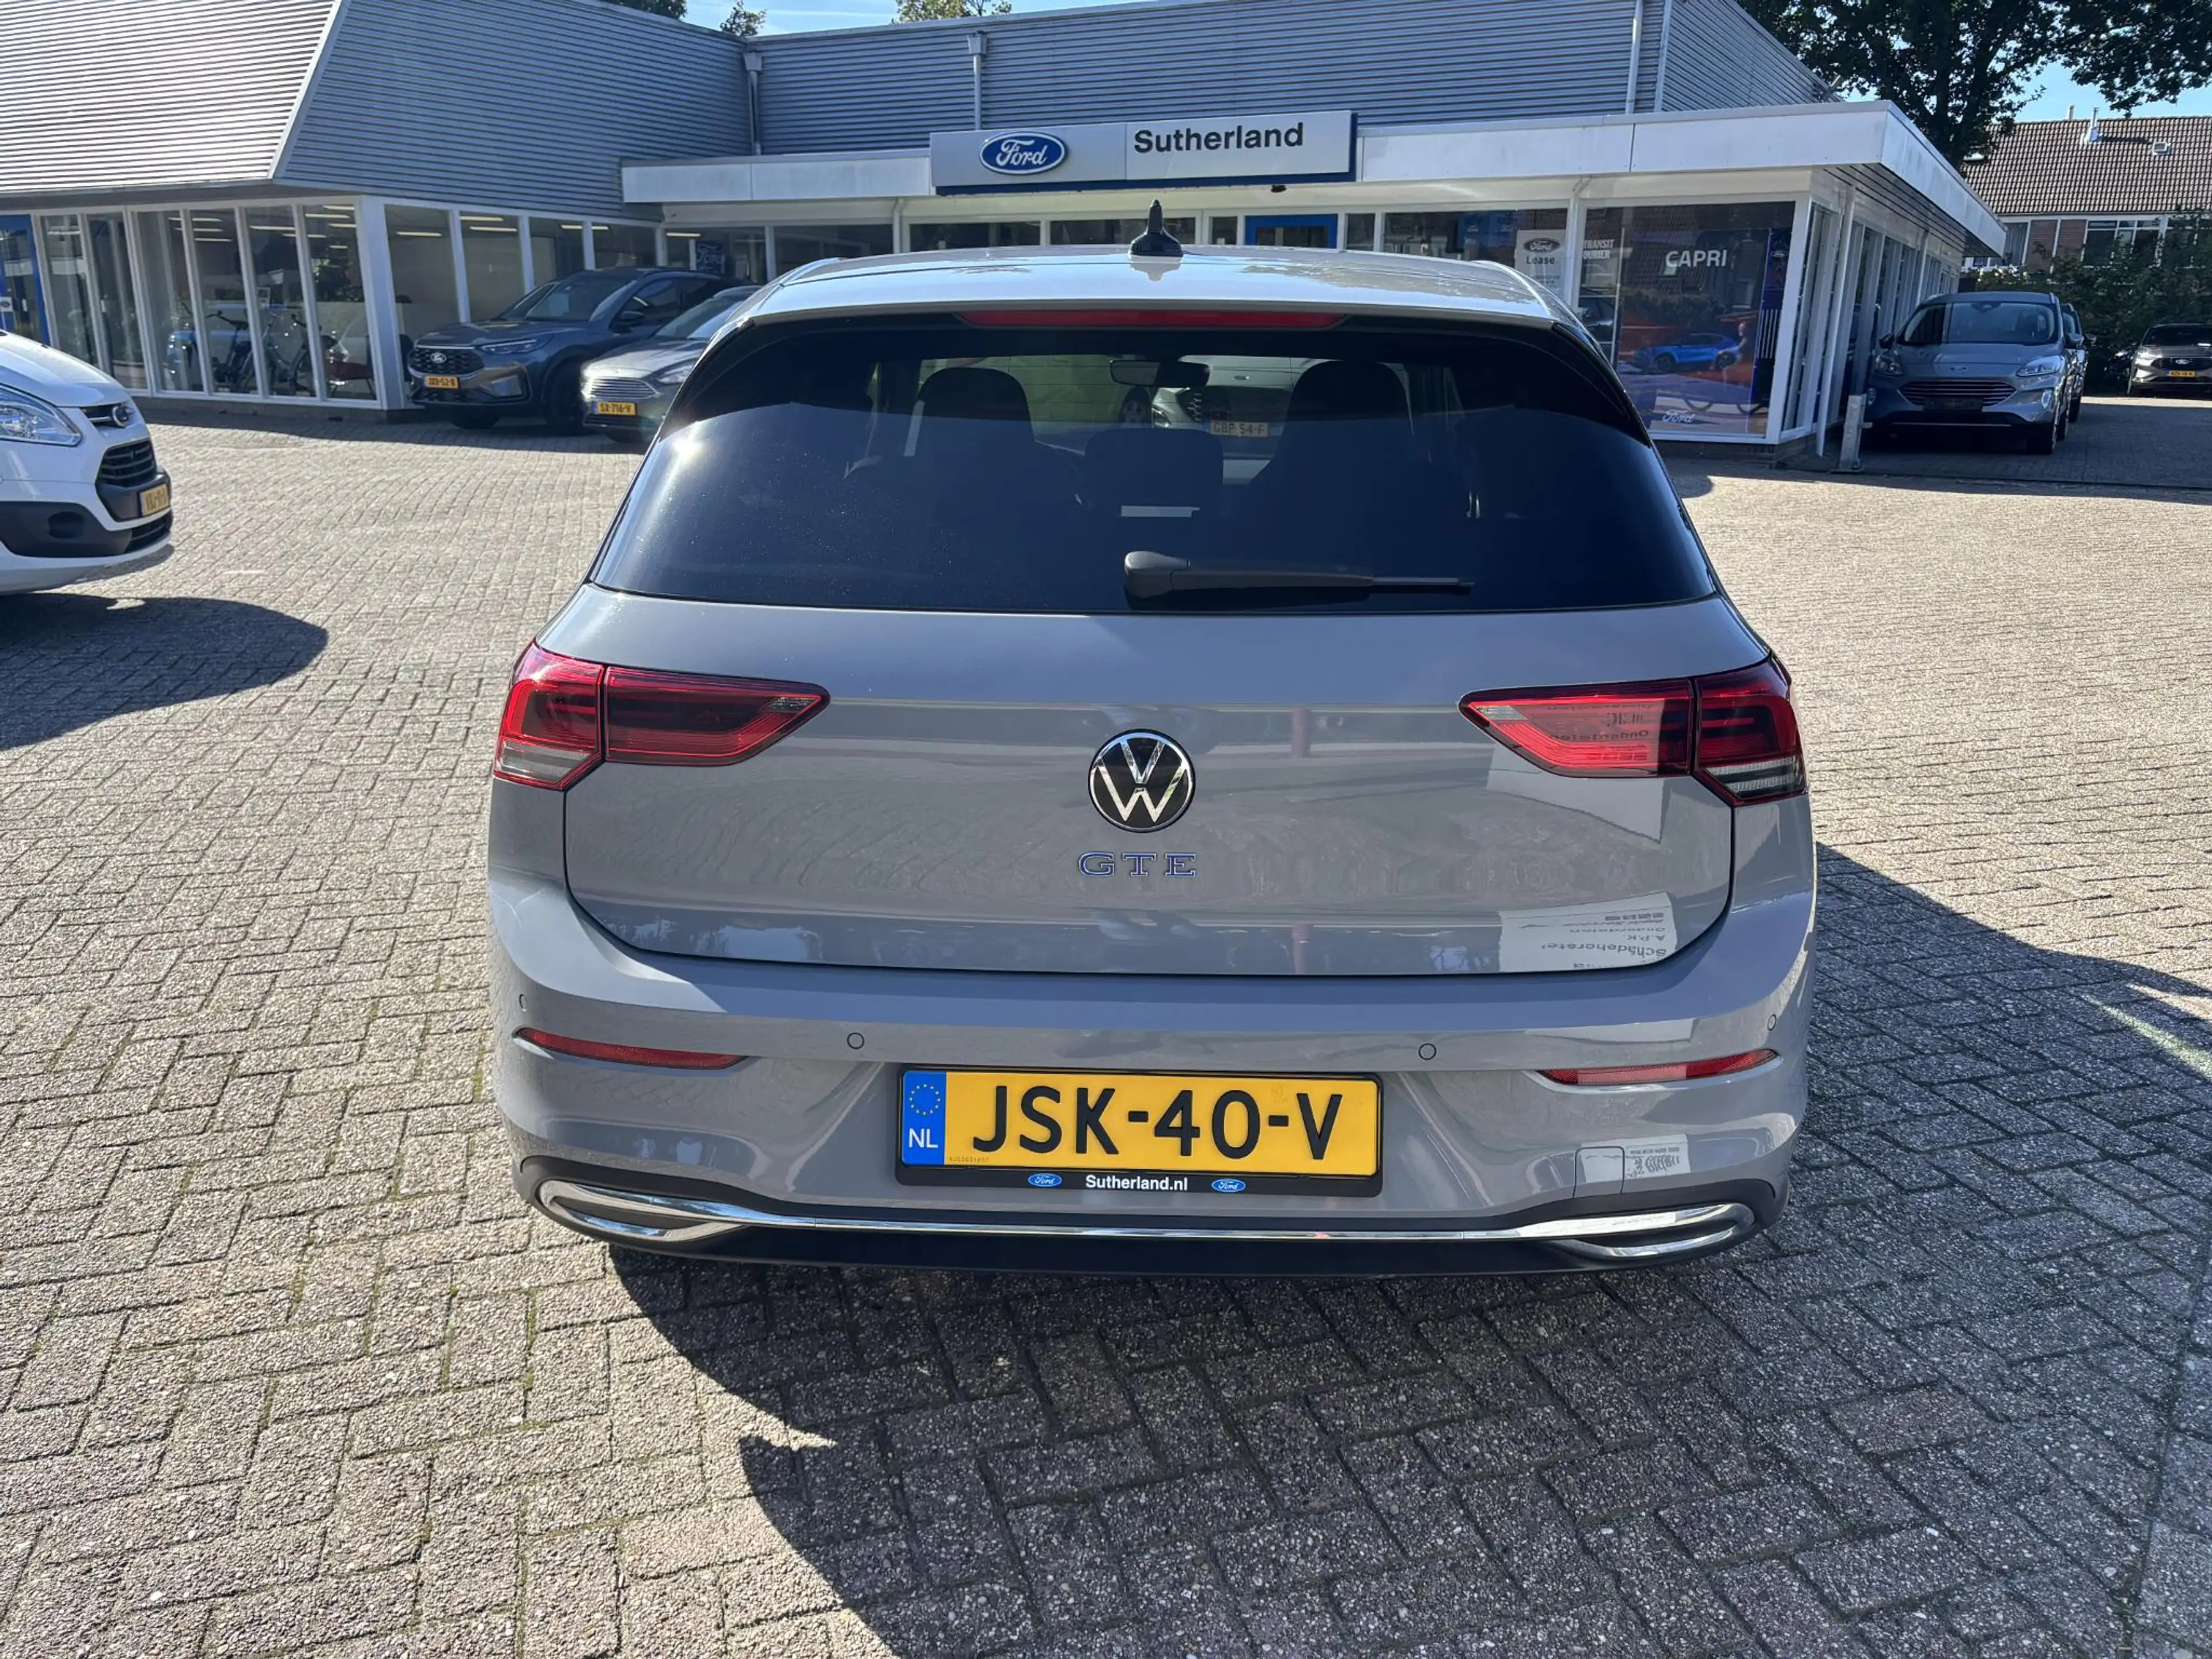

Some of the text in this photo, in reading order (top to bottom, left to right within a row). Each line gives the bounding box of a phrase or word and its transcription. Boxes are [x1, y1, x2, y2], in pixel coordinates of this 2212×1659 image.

[1134, 122, 1303, 153] Sutherland
[995, 139, 1048, 166] Ford
[1529, 239, 1554, 251] Ford
[1526, 256, 1555, 264] Lease
[1583, 249, 1611, 259] OURIER
[1665, 249, 1728, 267] CAPRI
[1662, 409, 1696, 423] Ford
[1213, 421, 1266, 435] GBP-54-F
[1078, 851, 1196, 877] GTE
[973, 1085, 1343, 1160] JSK-40-V
[908, 1128, 938, 1148] NL
[1085, 1174, 1188, 1191] Sutherland.nl
